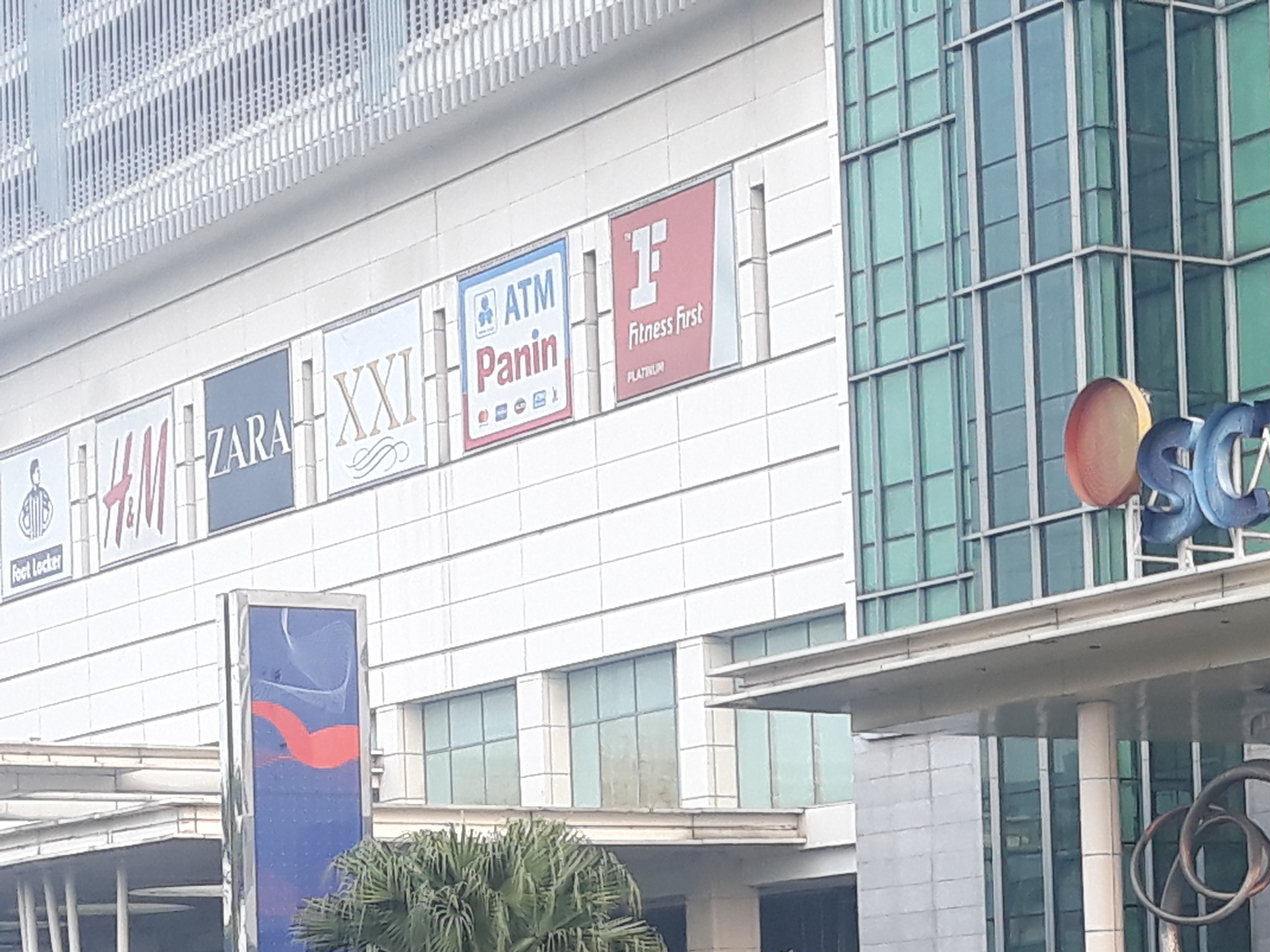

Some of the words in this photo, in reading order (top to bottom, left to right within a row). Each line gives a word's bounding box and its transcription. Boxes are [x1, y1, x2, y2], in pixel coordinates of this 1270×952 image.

[504, 268, 555, 326] ATM
[476, 328, 558, 394] Panin
[628, 317, 674, 350] Fitness
[333, 347, 417, 447] XXI
[627, 361, 665, 384] PLATINUM
[207, 408, 292, 479] ZARA
[103, 417, 169, 549] H&M
